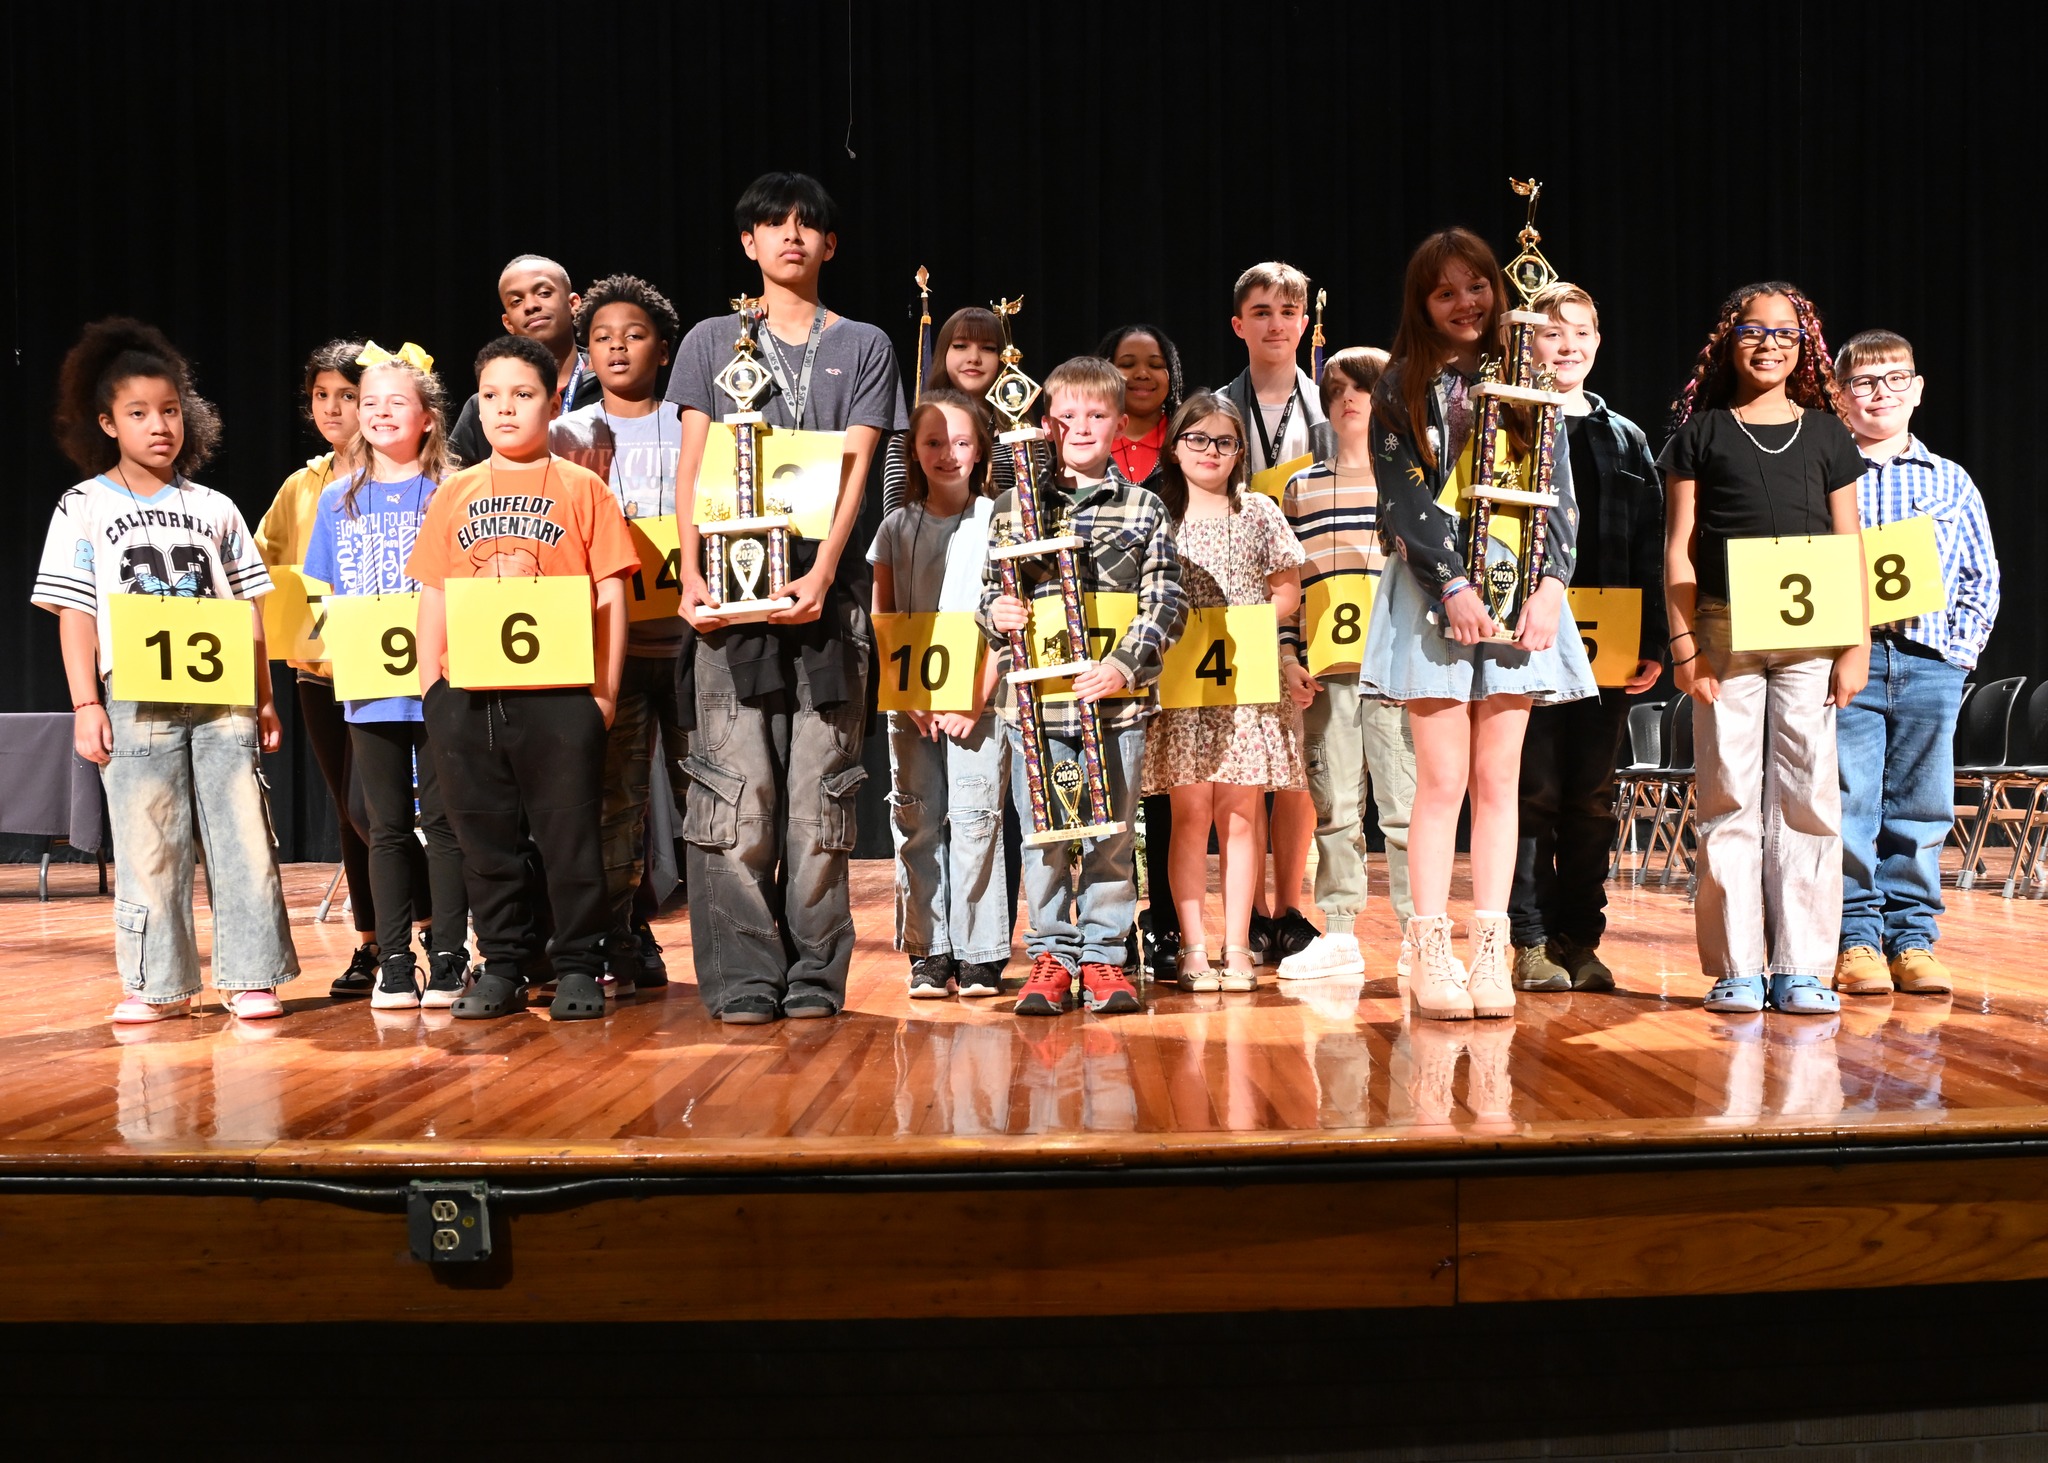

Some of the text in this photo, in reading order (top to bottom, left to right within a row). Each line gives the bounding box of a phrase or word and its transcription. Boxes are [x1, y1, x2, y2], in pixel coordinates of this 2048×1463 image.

[105, 509, 214, 545] CALIFORNIA
[468, 495, 556, 519] KOHFELDT
[74, 538, 96, 575] 2
[457, 515, 566, 551] ELEMENTARY
[631, 547, 684, 602] 14
[1492, 570, 1514, 581] 2026
[1874, 554, 1911, 601] 8
[1331, 602, 1362, 645] 8
[1780, 573, 1815, 627] 3
[145, 630, 224, 683] 13
[381, 627, 418, 676] 9
[501, 612, 540, 664] 6
[890, 644, 951, 692] 10
[1195, 639, 1233, 686] 4
[1055, 769, 1079, 783] 2026
